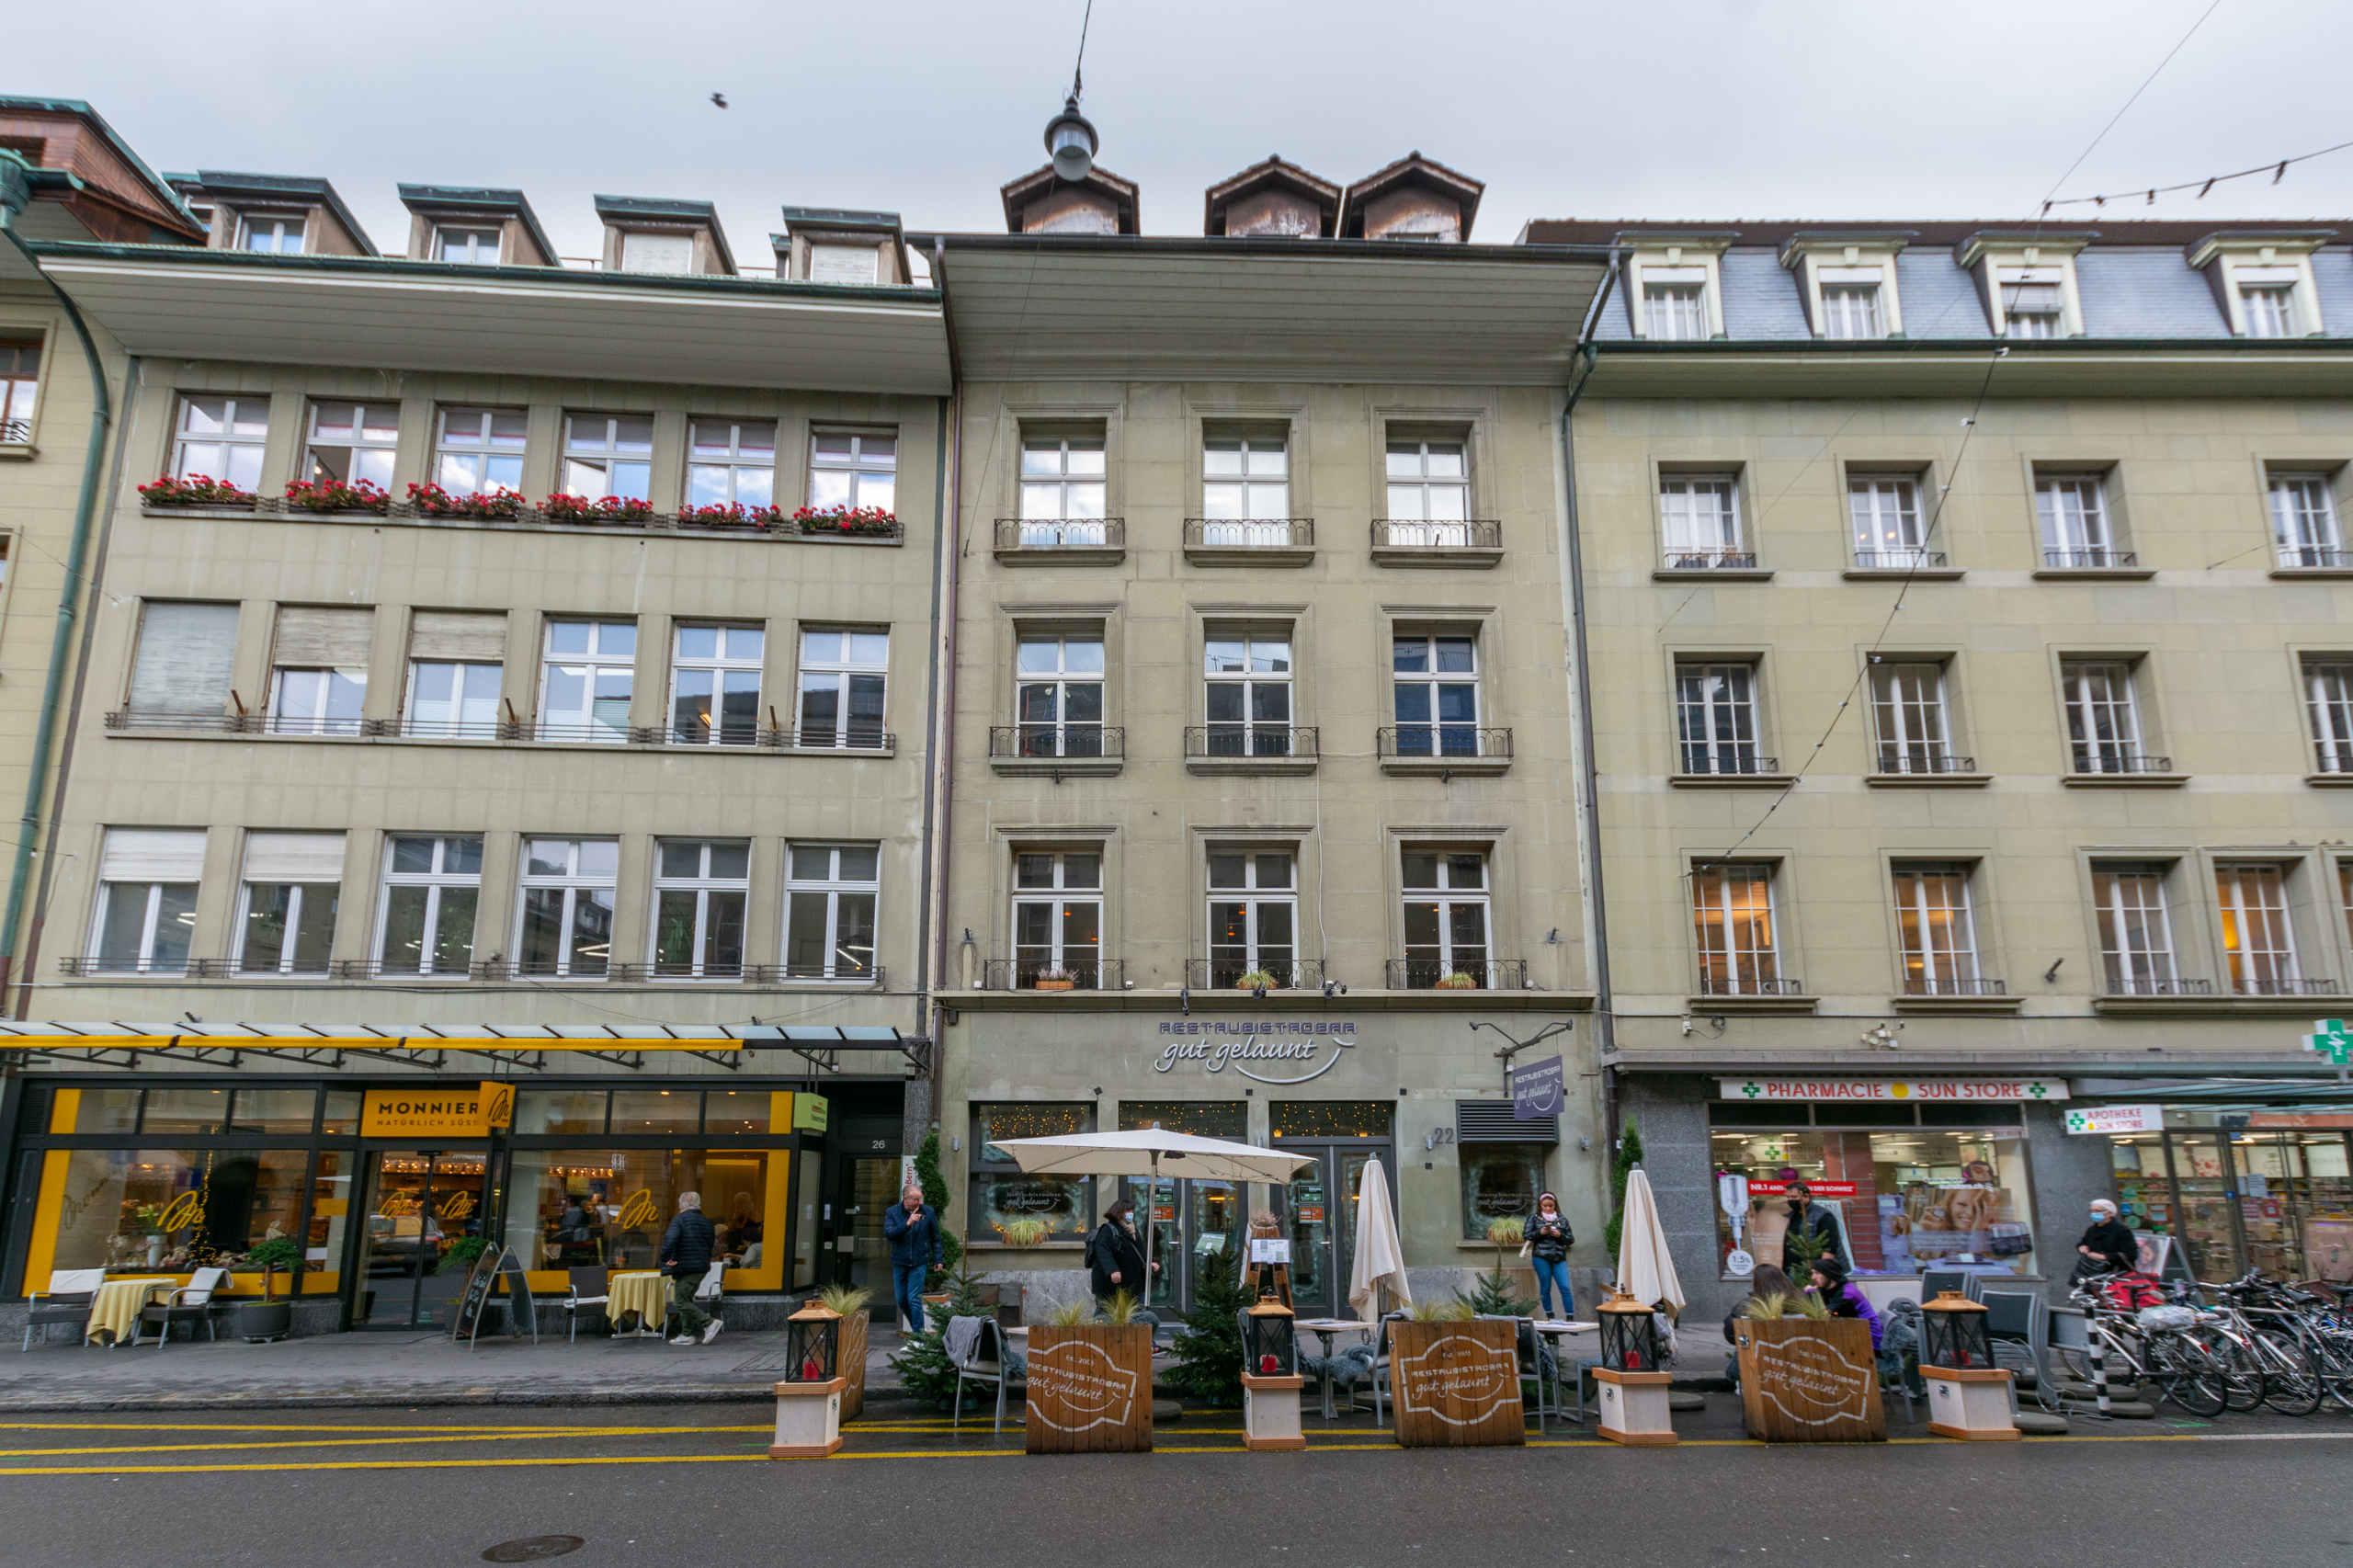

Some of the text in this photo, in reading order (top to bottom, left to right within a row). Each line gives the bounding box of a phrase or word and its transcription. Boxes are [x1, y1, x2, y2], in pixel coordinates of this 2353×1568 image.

[1159, 1022, 1358, 1035] RESTAUBISTROBAR
[1154, 1034, 1318, 1073] gut gelaunt
[1515, 1065, 1562, 1085] RESTAUBISTROBAR
[1515, 1080, 1552, 1109] gut gelaunt
[1767, 1083, 2023, 1098] PHARMACIE SUN STORE
[379, 1102, 478, 1114] MONNIER
[2086, 1108, 2143, 1119] APOTHEKE
[377, 1118, 444, 1126] NATÜRLICH
[2096, 1120, 2143, 1131] SUN STORE
[1434, 1127, 1454, 1144] 22
[872, 1140, 885, 1149] 26
[1028, 1362, 1126, 1391] RESTAUBISTROBAR
[1411, 1362, 1509, 1378] RESTAUBISTROBAR
[1027, 1376, 1103, 1401] gut gelaunt
[1412, 1375, 1492, 1400] gut gelaunt
